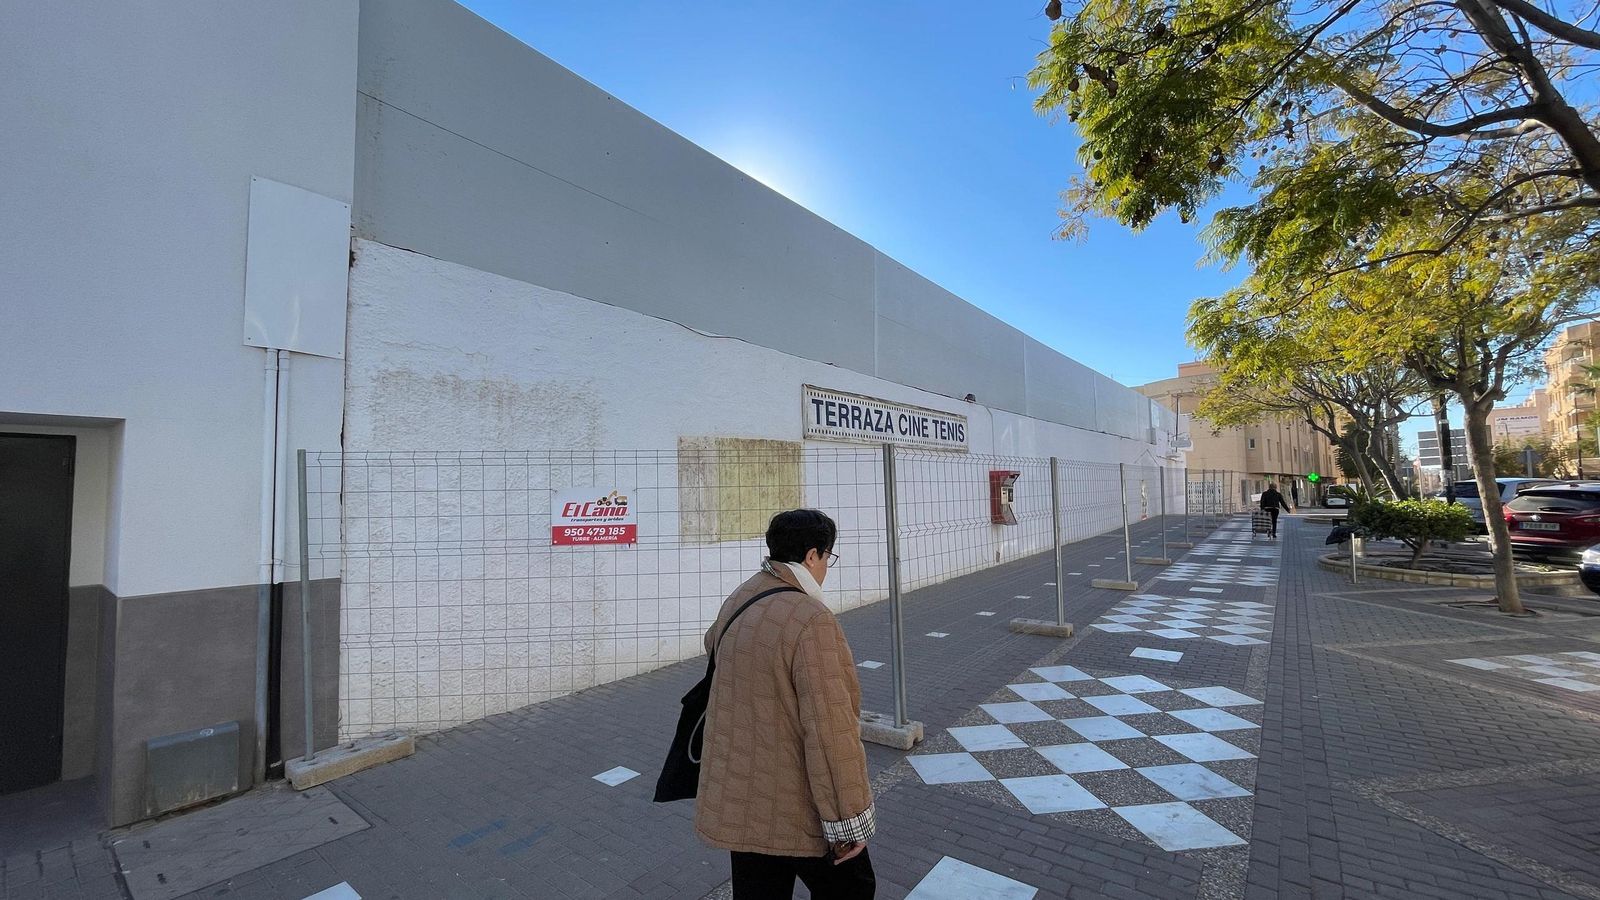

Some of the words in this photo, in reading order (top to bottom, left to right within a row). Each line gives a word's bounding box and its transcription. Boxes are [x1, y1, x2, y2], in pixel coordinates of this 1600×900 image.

[811, 398, 894, 434] TERRAZA
[898, 413, 929, 439] CINE
[932, 419, 965, 443] TENIS
[564, 528, 584, 537] 950
[586, 527, 606, 536] 479
[608, 526, 626, 535] 185
